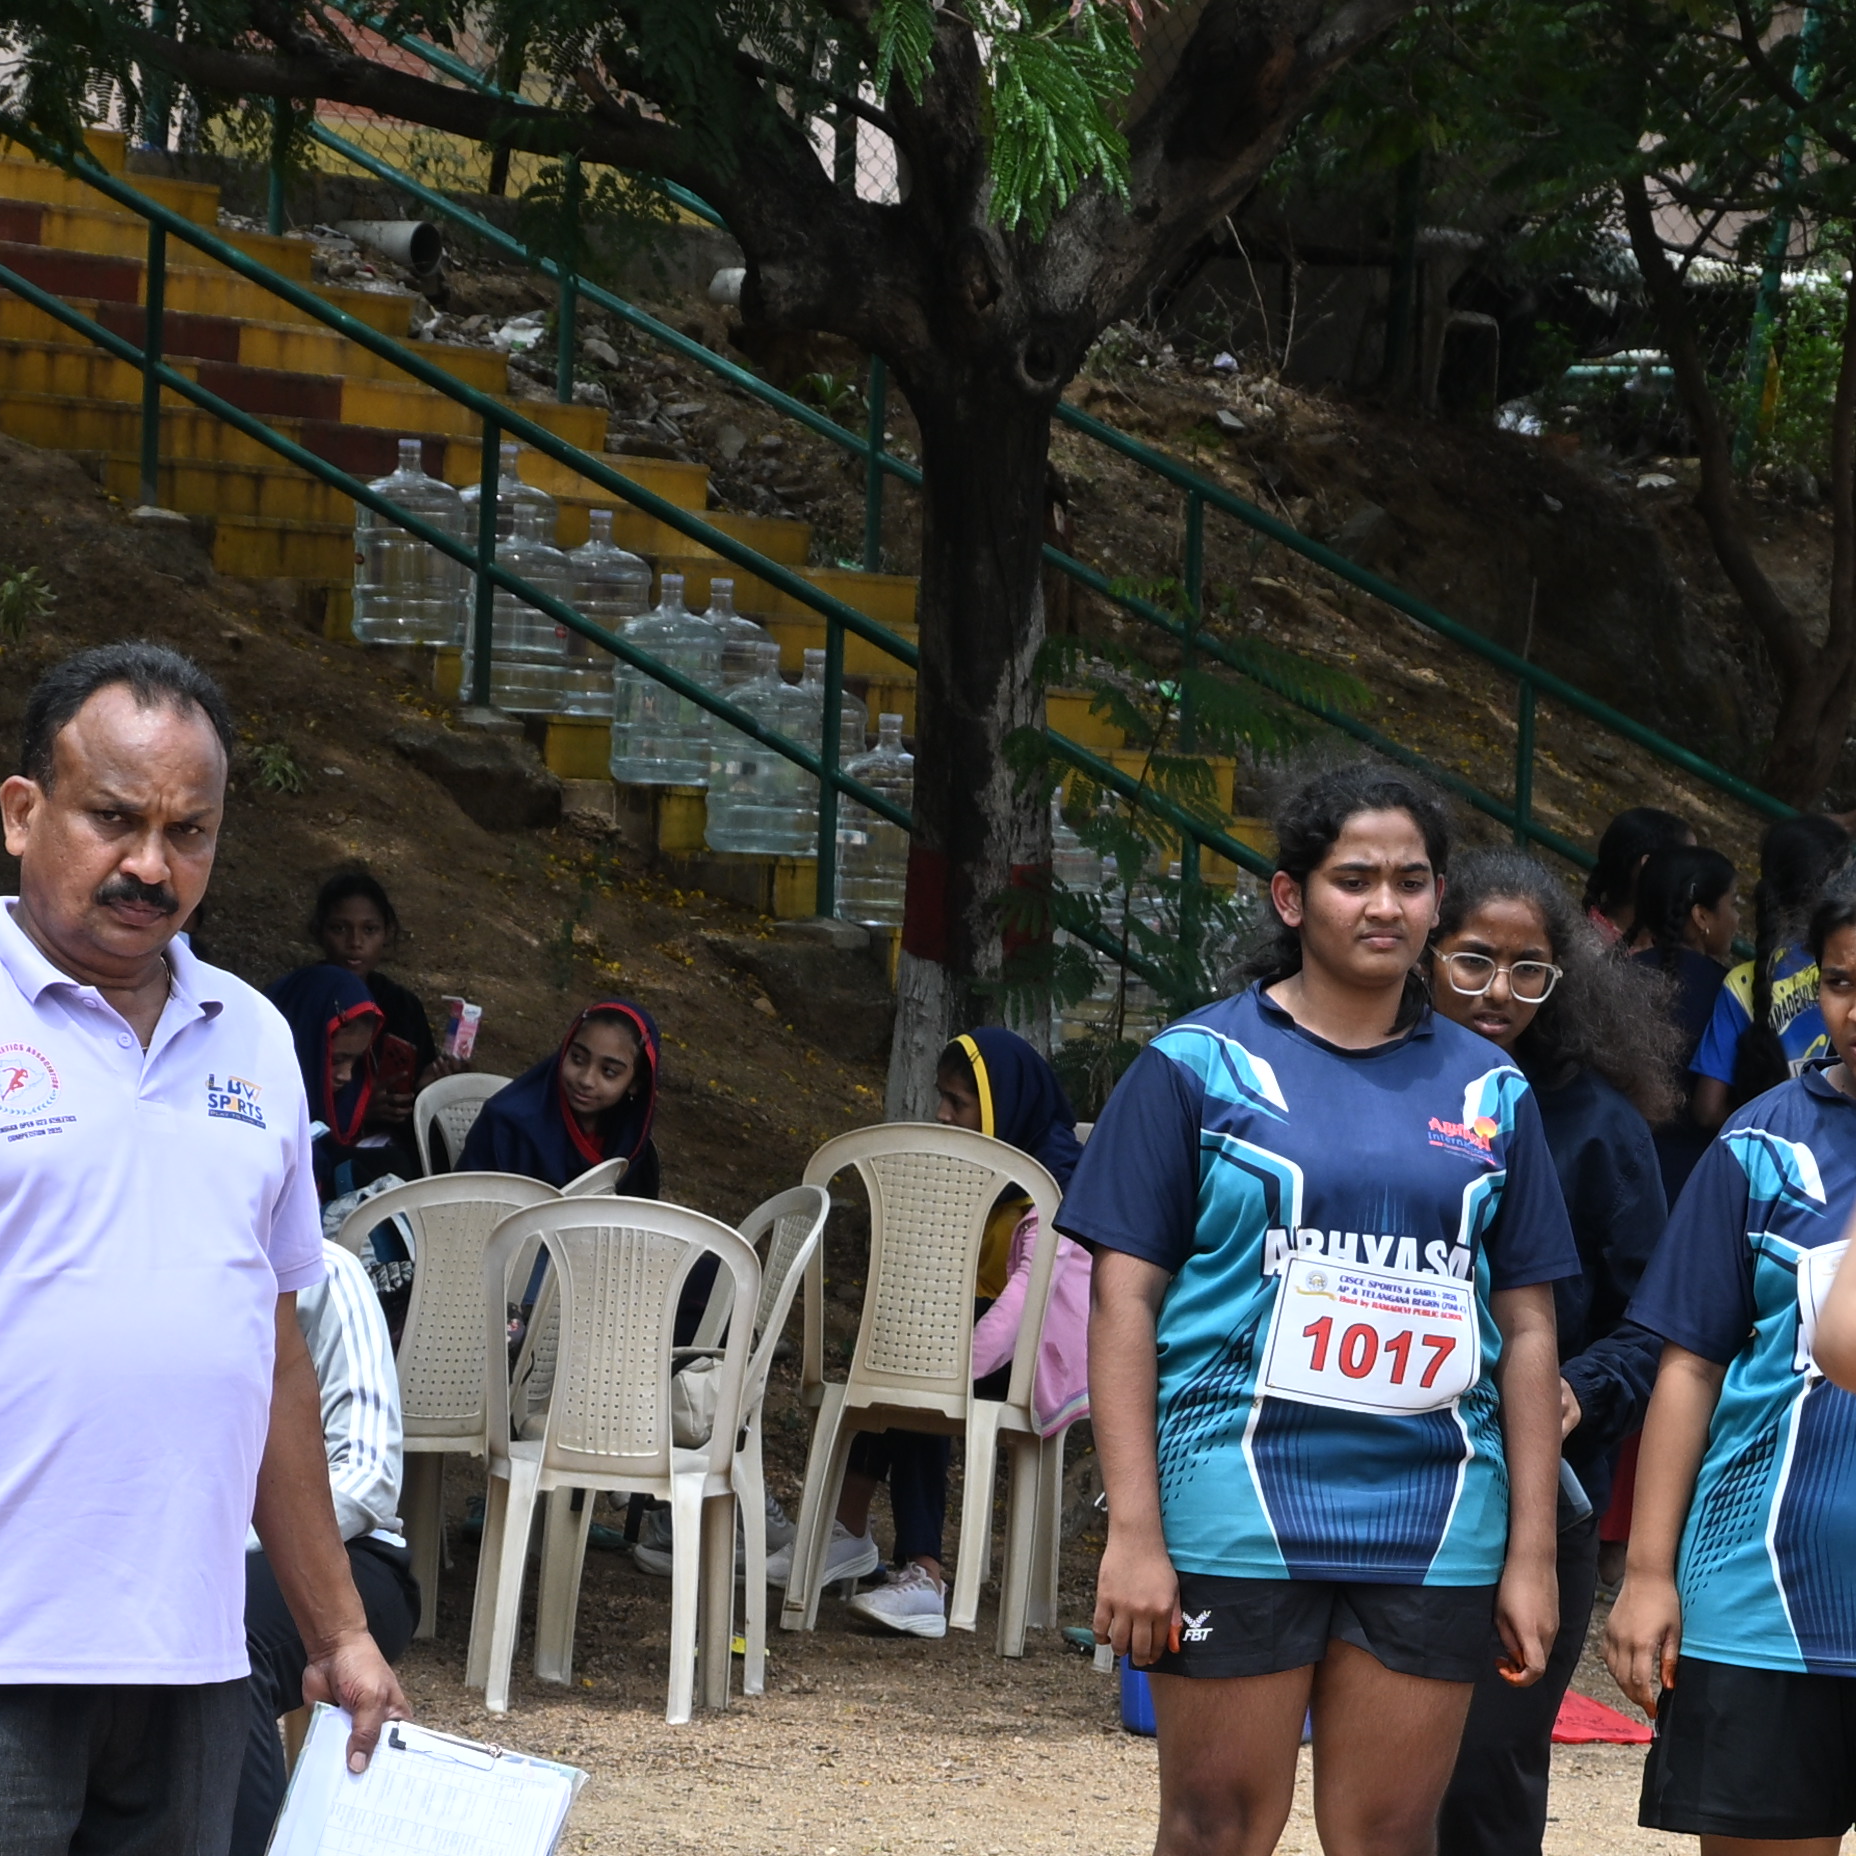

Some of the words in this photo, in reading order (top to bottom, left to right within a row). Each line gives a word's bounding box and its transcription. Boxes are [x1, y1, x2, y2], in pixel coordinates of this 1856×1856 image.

[1368, 1280, 1403, 1294] SPORTS
[1302, 1315, 1457, 1389] 1017
[1181, 1627, 1214, 1642] FBT
